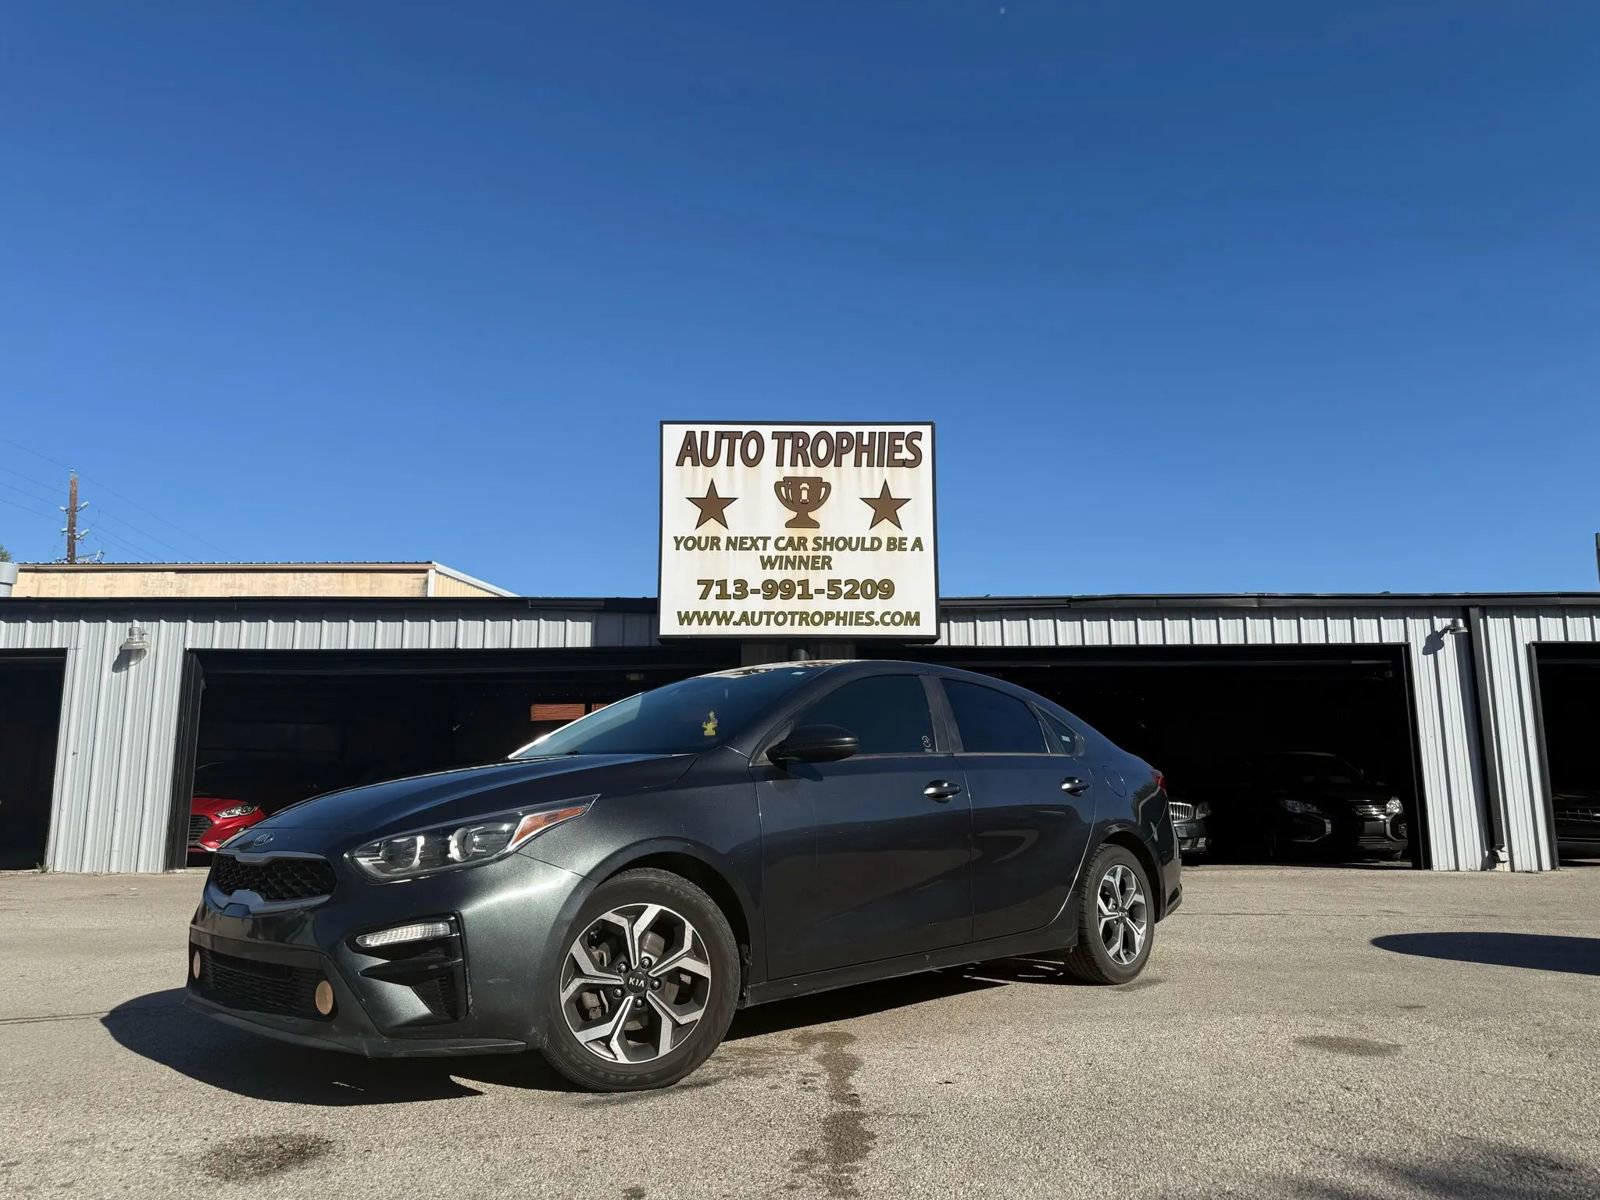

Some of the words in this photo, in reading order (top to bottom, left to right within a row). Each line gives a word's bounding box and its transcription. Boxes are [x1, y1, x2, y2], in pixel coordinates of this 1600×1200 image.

[675, 430, 765, 468] AUTO
[771, 430, 923, 469] TROPHIES
[673, 535, 722, 552] YOUR
[725, 535, 772, 552] NEXT
[773, 535, 809, 552] CAR
[811, 535, 883, 552] SHOULD
[885, 536, 908, 552] BE
[909, 536, 925, 552] A
[759, 554, 833, 571] WINNER
[696, 578, 895, 601] 713-991-5209
[676, 610, 921, 627] WWW.AUTOTROPHIES.COM
[628, 976, 645, 988] KIA
